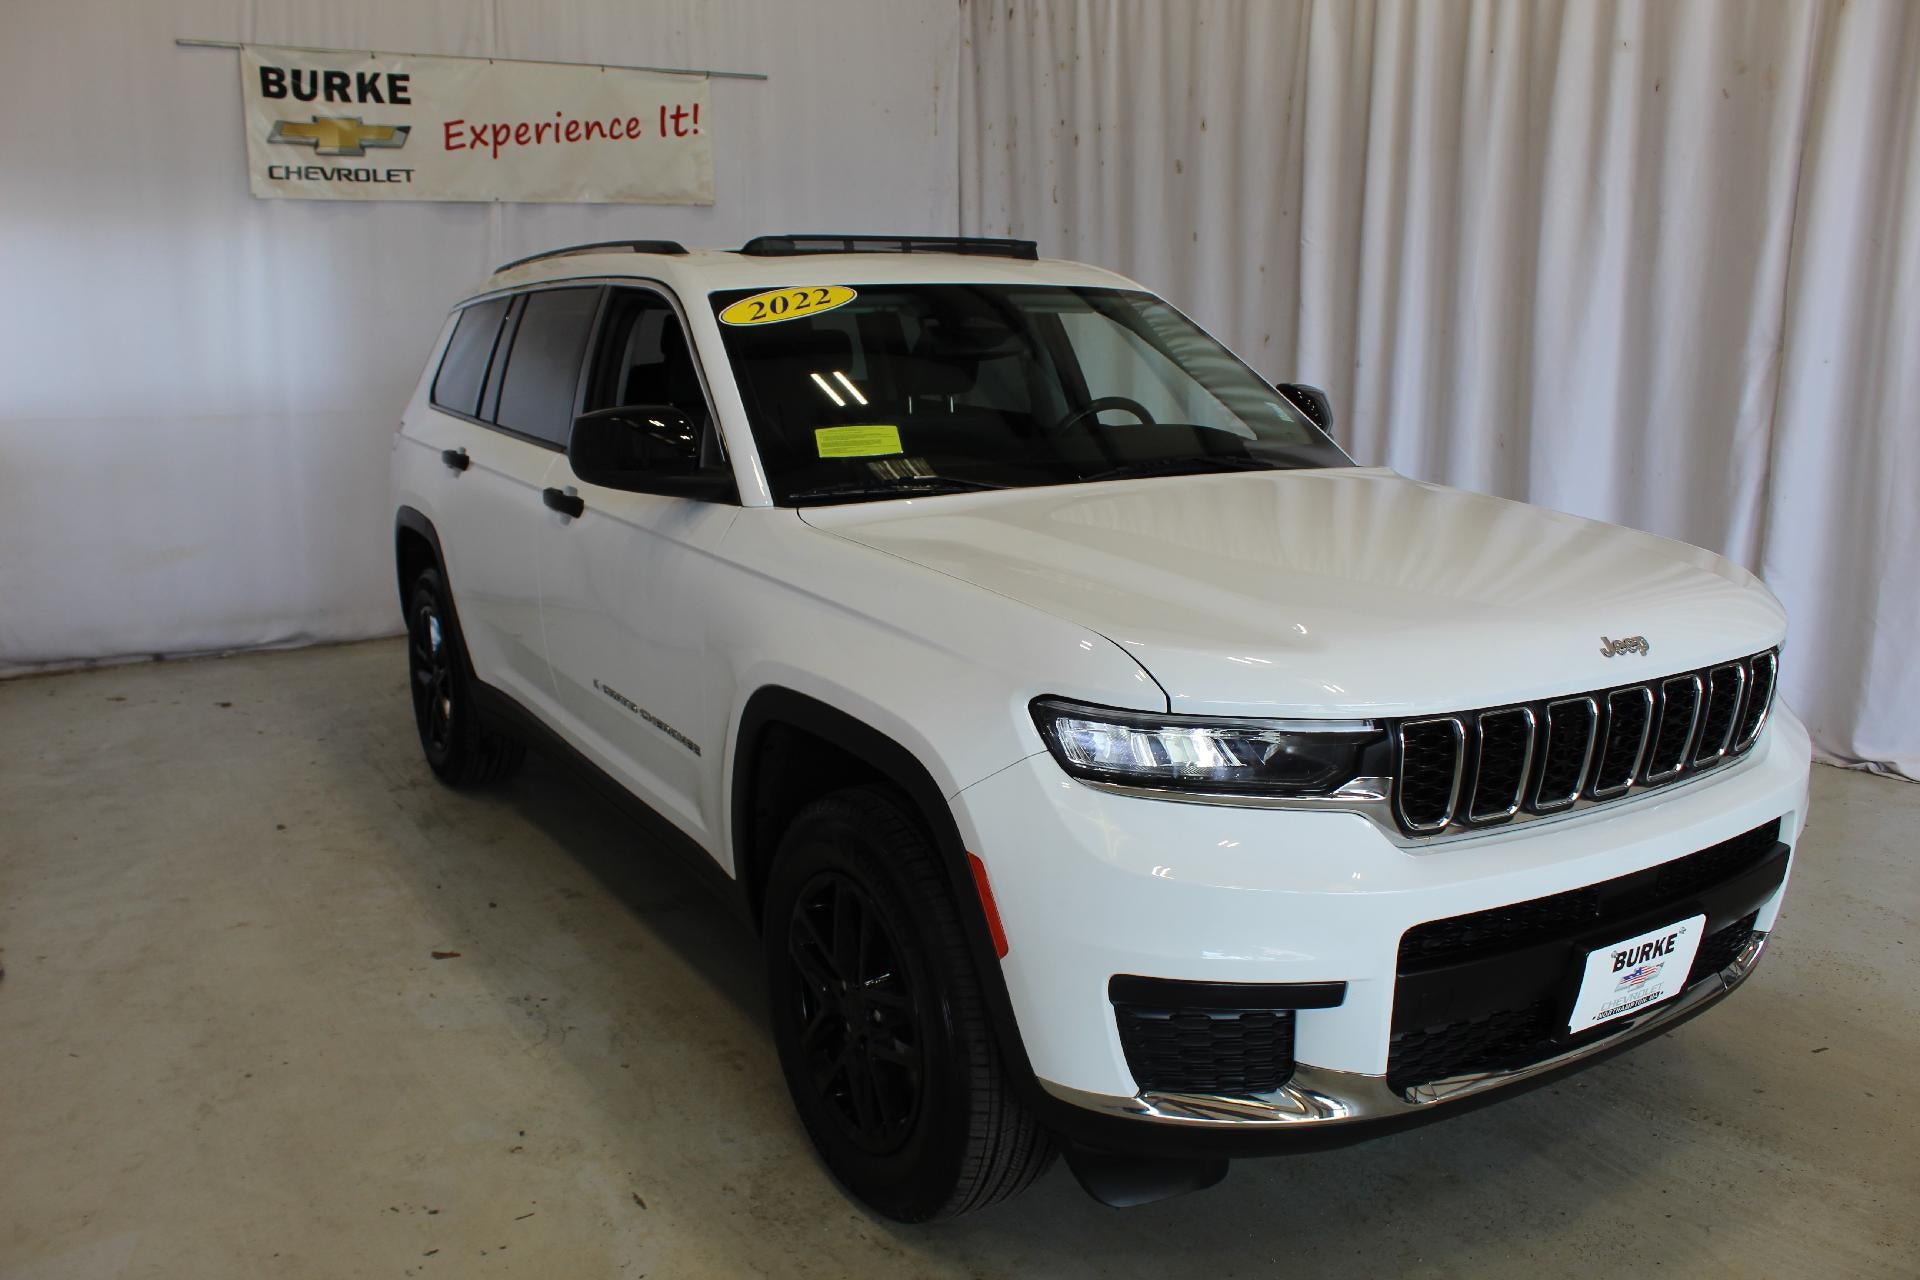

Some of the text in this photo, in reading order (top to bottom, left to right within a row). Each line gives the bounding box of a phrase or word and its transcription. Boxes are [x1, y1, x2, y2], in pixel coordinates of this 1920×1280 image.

[259, 65, 412, 105] BURKE
[443, 102, 699, 159] Experience It!
[267, 164, 416, 184] CHEVROLET
[748, 287, 832, 321] 2022
[1600, 635, 1650, 658] Jeep
[1612, 932, 1678, 974] BURKE
[1600, 981, 1664, 1012] CHEVROLET
